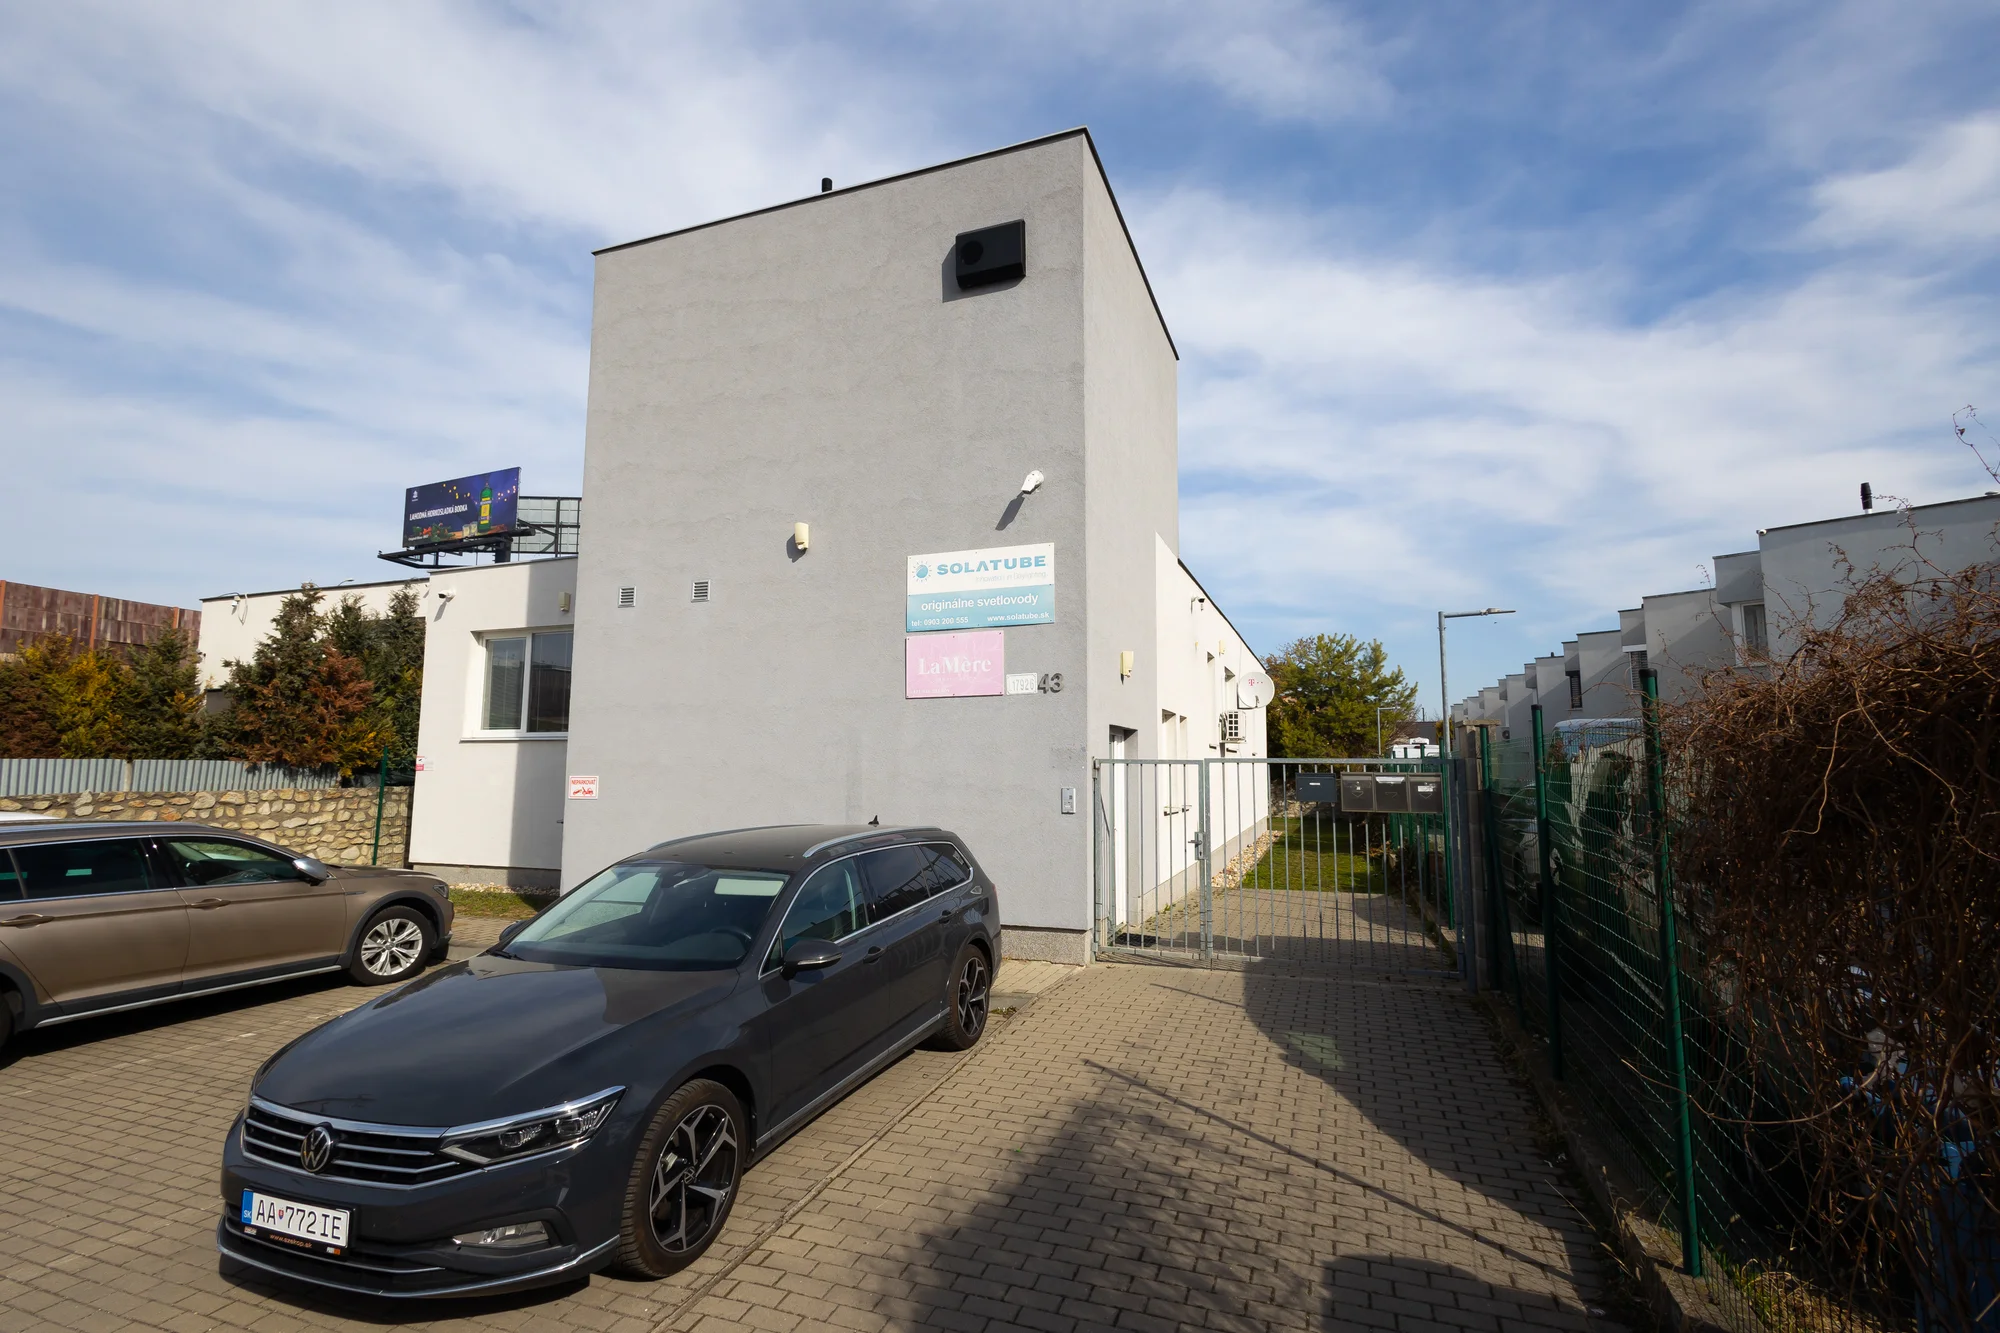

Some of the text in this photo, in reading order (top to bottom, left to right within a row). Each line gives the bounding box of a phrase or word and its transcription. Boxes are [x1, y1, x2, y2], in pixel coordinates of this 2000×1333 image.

[936, 555, 1046, 575] SOLATUBE
[921, 593, 1039, 612] originálne svetlovody
[923, 618, 940, 626] 0903
[941, 617, 954, 625] 200
[956, 616, 969, 624] 555
[987, 612, 1050, 622] www.solatube.sk
[918, 656, 992, 675] LaMère
[1037, 673, 1064, 694] 43
[243, 1209, 252, 1219] SK
